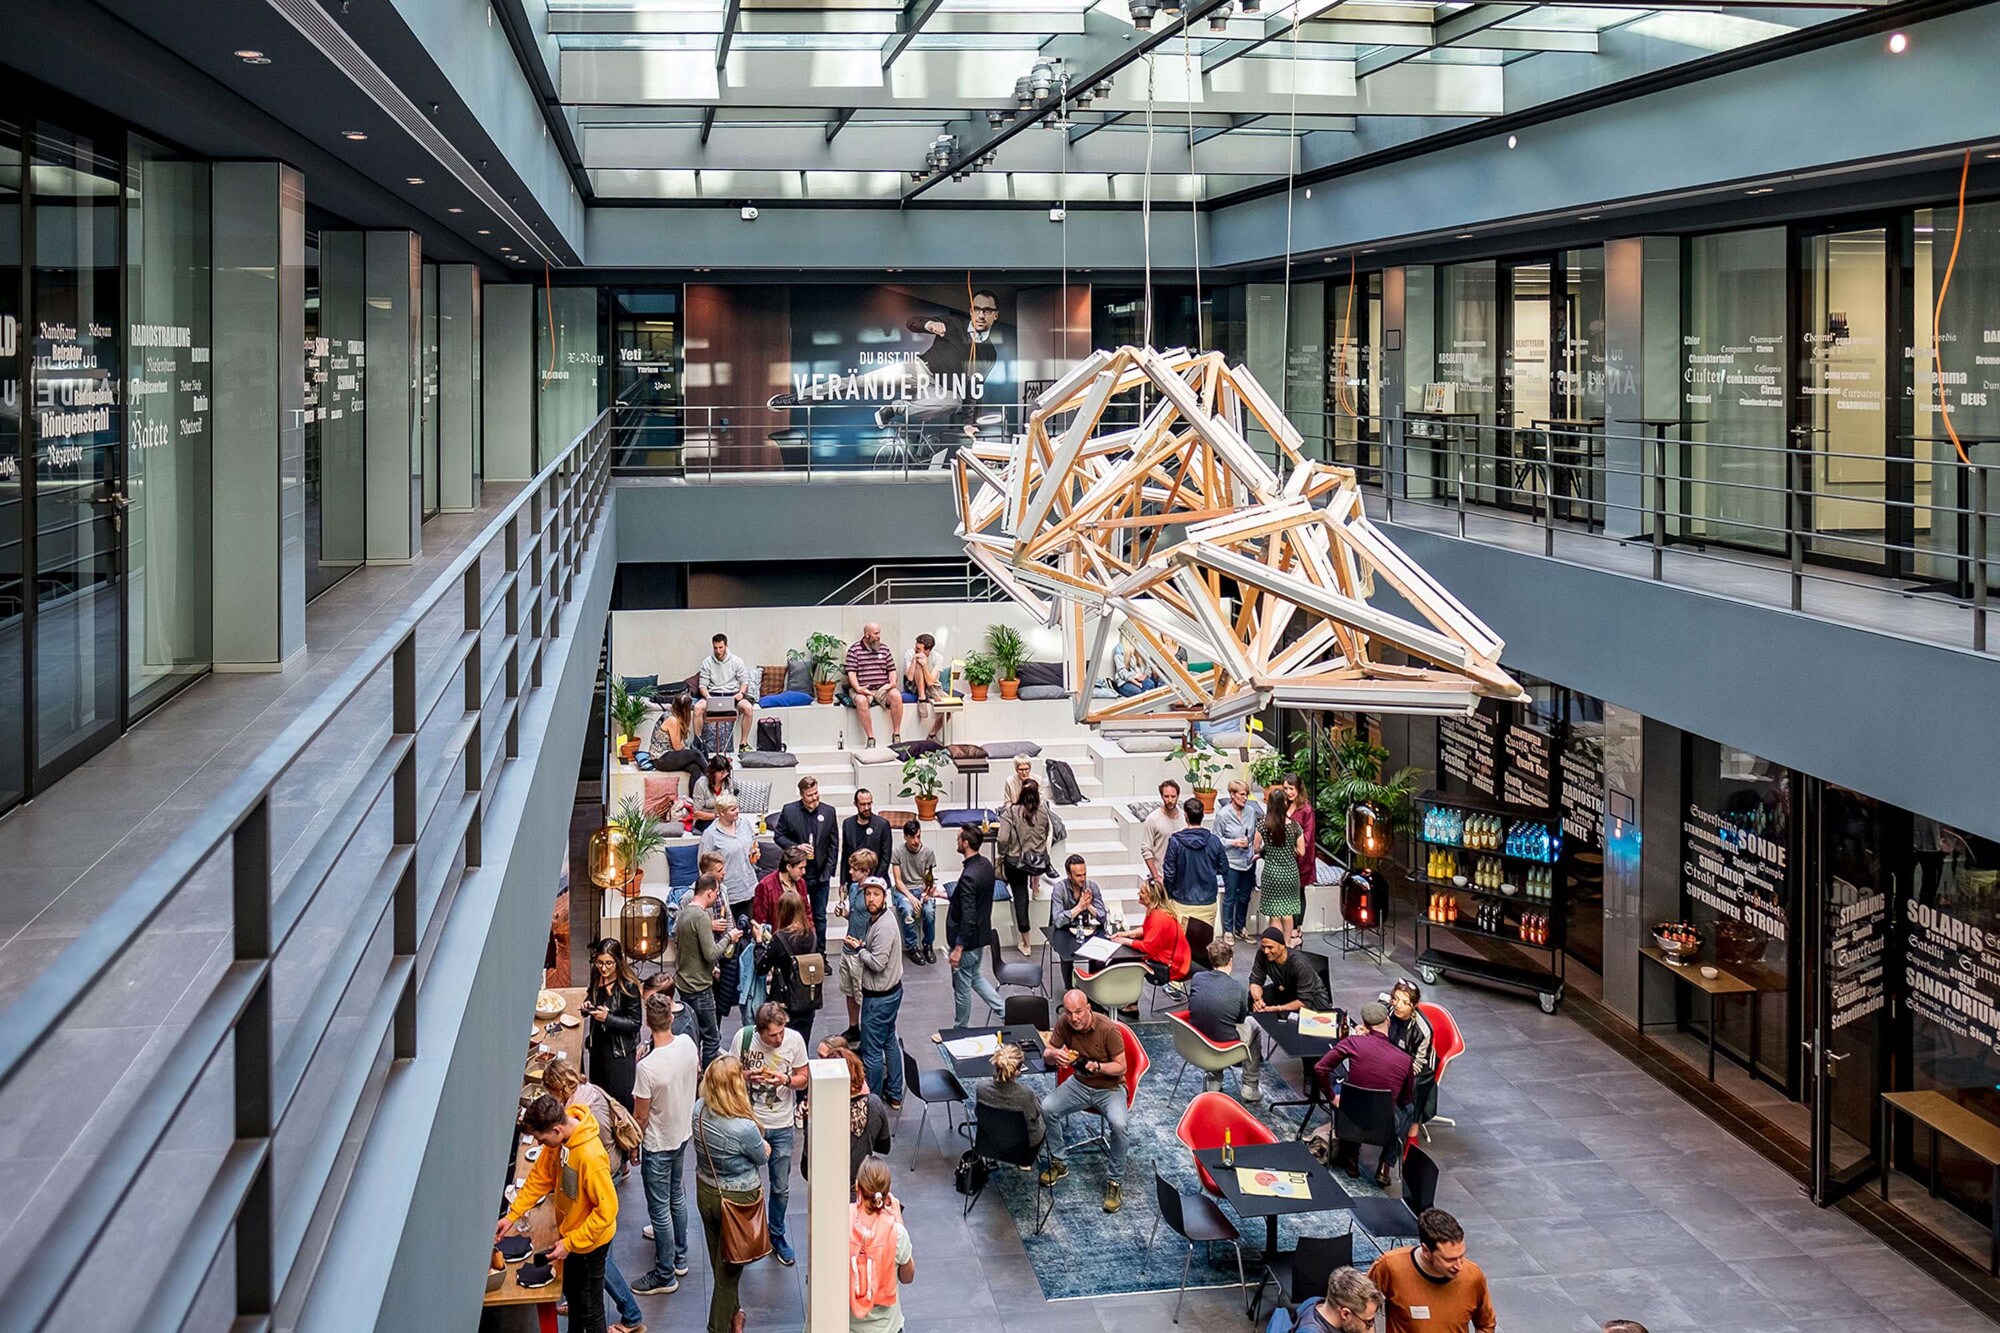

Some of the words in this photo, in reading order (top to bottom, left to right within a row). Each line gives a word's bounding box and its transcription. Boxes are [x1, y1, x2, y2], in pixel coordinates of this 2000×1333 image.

[131, 324, 191, 347] RADIOSTRAHLUNG
[567, 352, 604, 365] X-Ray
[620, 348, 642, 361] Yeti
[859, 351, 873, 365] DU
[877, 351, 900, 365] BIST
[904, 351, 920, 365] DIE
[541, 370, 569, 380] Xenon
[793, 368, 985, 401] VERÄNDERUNG
[1760, 384, 1783, 396] Cirrus
[1961, 393, 1987, 406] DEUS
[42, 407, 109, 438] Röntgenstrahl
[47, 444, 83, 468] Rezeptor
[1684, 821, 1740, 855] STANDARDMODELL
[1738, 828, 1786, 867] SONDE
[1683, 861, 1715, 888] Strahl
[1698, 854, 1745, 887] SIMULATOR
[1686, 881, 1741, 920] SUPERHAUFEN
[1716, 882, 1738, 901] SONNE
[1840, 893, 1885, 926] STRAHLUNG
[1744, 905, 1785, 941] STROM
[1907, 898, 1983, 952] SOLARIS
[1908, 934, 1944, 960] Satellit
[1925, 929, 1957, 951] System
[1949, 967, 1976, 988] SIRENE
[1905, 997, 1967, 1037] Schneewittchen
[1969, 1025, 1992, 1046] Sinn
